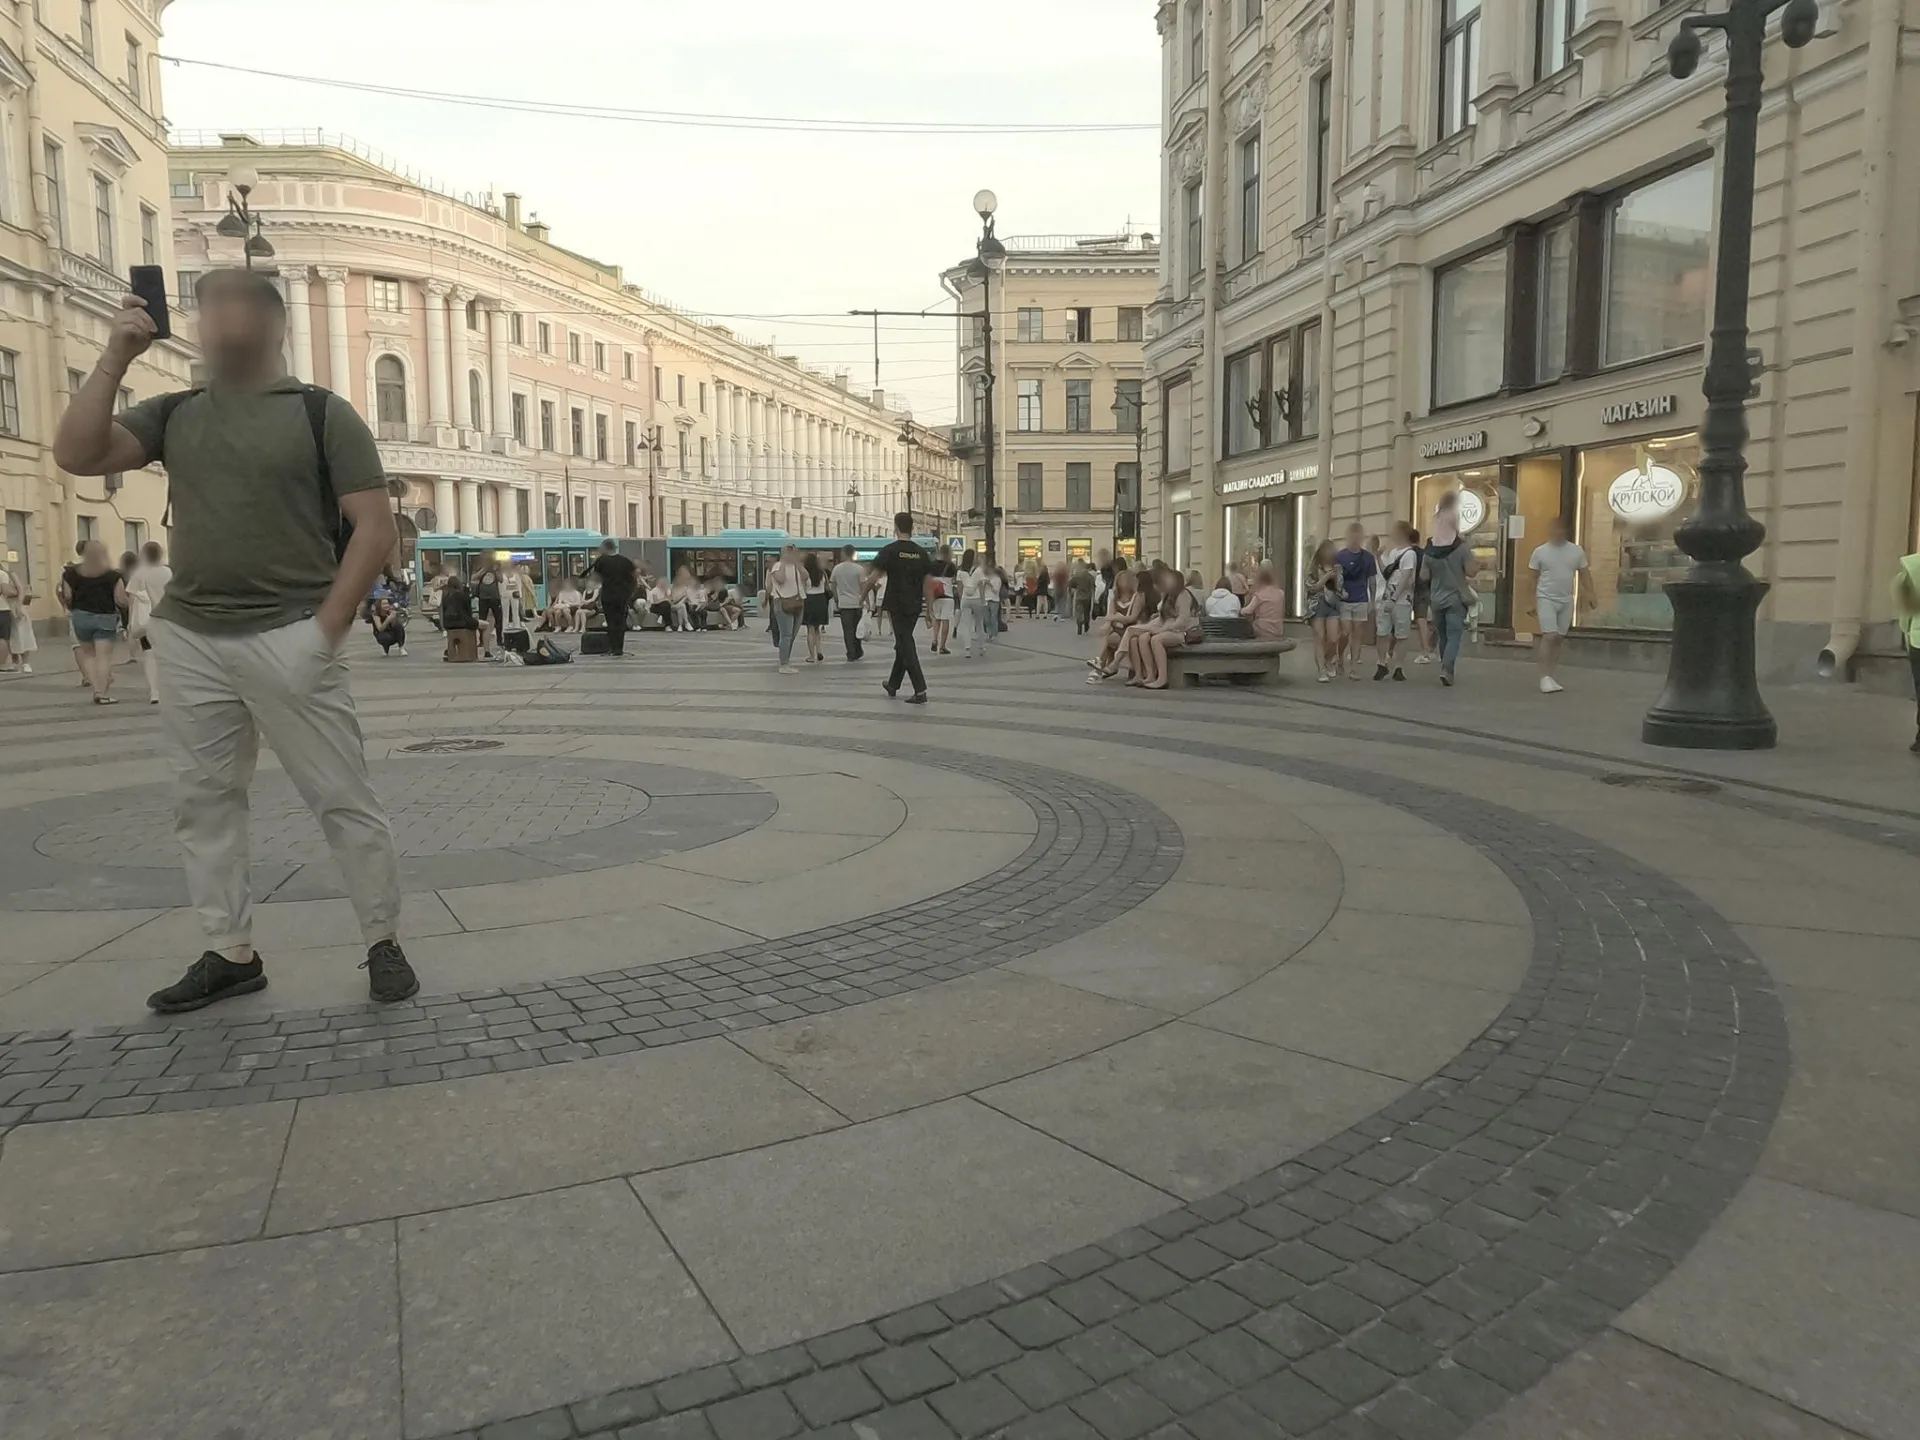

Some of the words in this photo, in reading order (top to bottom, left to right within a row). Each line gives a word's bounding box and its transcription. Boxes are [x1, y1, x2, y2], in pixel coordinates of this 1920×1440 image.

[1600, 395, 1671, 425] МАГАЗИН
[1419, 431, 1484, 458] ФИРМЕННЫЙ
[1223, 479, 1249, 493] МАГАЗИН
[1248, 469, 1286, 489] СЛАДОСТЕЙ
[1611, 484, 1676, 513] КРУПСКОЙ
